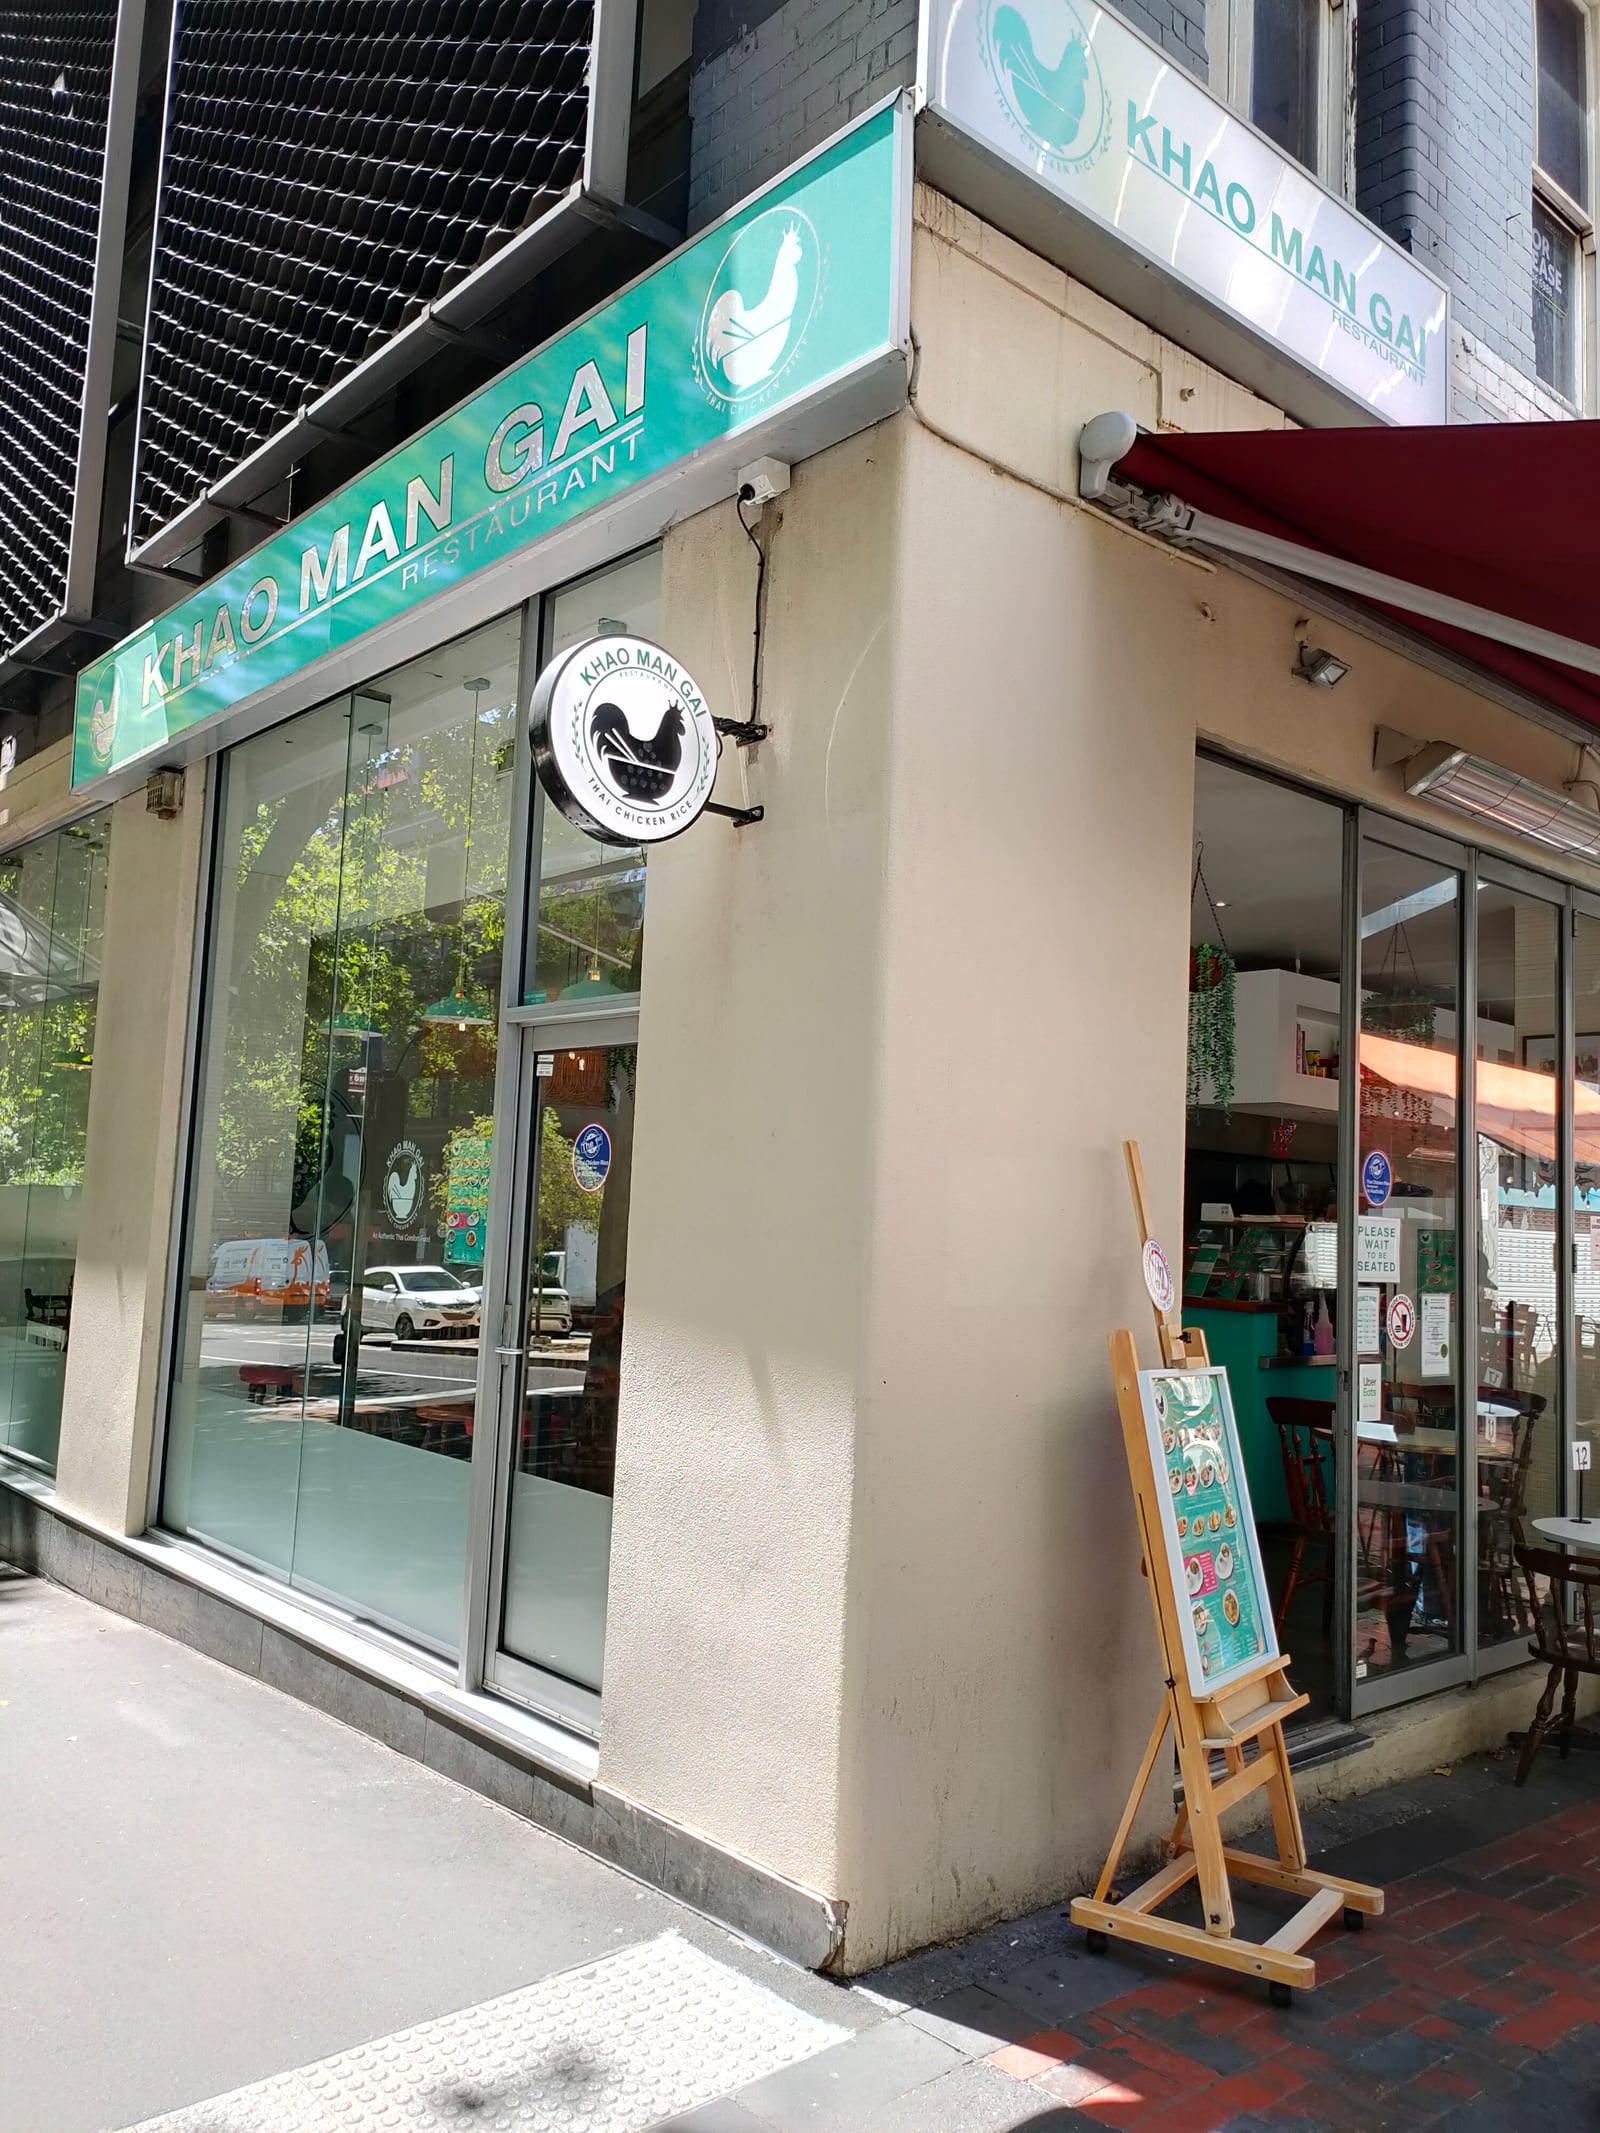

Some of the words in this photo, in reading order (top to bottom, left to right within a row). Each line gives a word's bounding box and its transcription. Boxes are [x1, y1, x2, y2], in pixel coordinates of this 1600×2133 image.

[1127, 98, 1255, 235] KHAO
[1271, 210, 1356, 316] MAN
[1369, 292, 1426, 366] GAI
[1532, 228, 1550, 262] OR
[1532, 248, 1563, 295] EASE
[1332, 308, 1427, 387] RESTAURANT
[141, 575, 279, 709] KHAO
[299, 451, 454, 615] MAN
[484, 322, 648, 494] GAI
[402, 427, 645, 592] RESTAURANT
[580, 648, 630, 686] KHAO
[637, 648, 678, 682] MAN
[680, 680, 707, 718] GAI
[619, 670, 673, 692] RESTAURANT
[588, 777, 611, 806] THAI
[615, 806, 666, 826] CHICKEN
[671, 800, 693, 821] RICE
[386, 1143, 402, 1168] KHAO
[1358, 1225, 1396, 1238] PLEASE
[1365, 1239, 1389, 1250] WAIT
[1357, 1260, 1396, 1272] SEATED
[1367, 1251, 1376, 1260] TO
[1378, 1251, 1387, 1260] BE
[1576, 1446, 1588, 1466] 12
